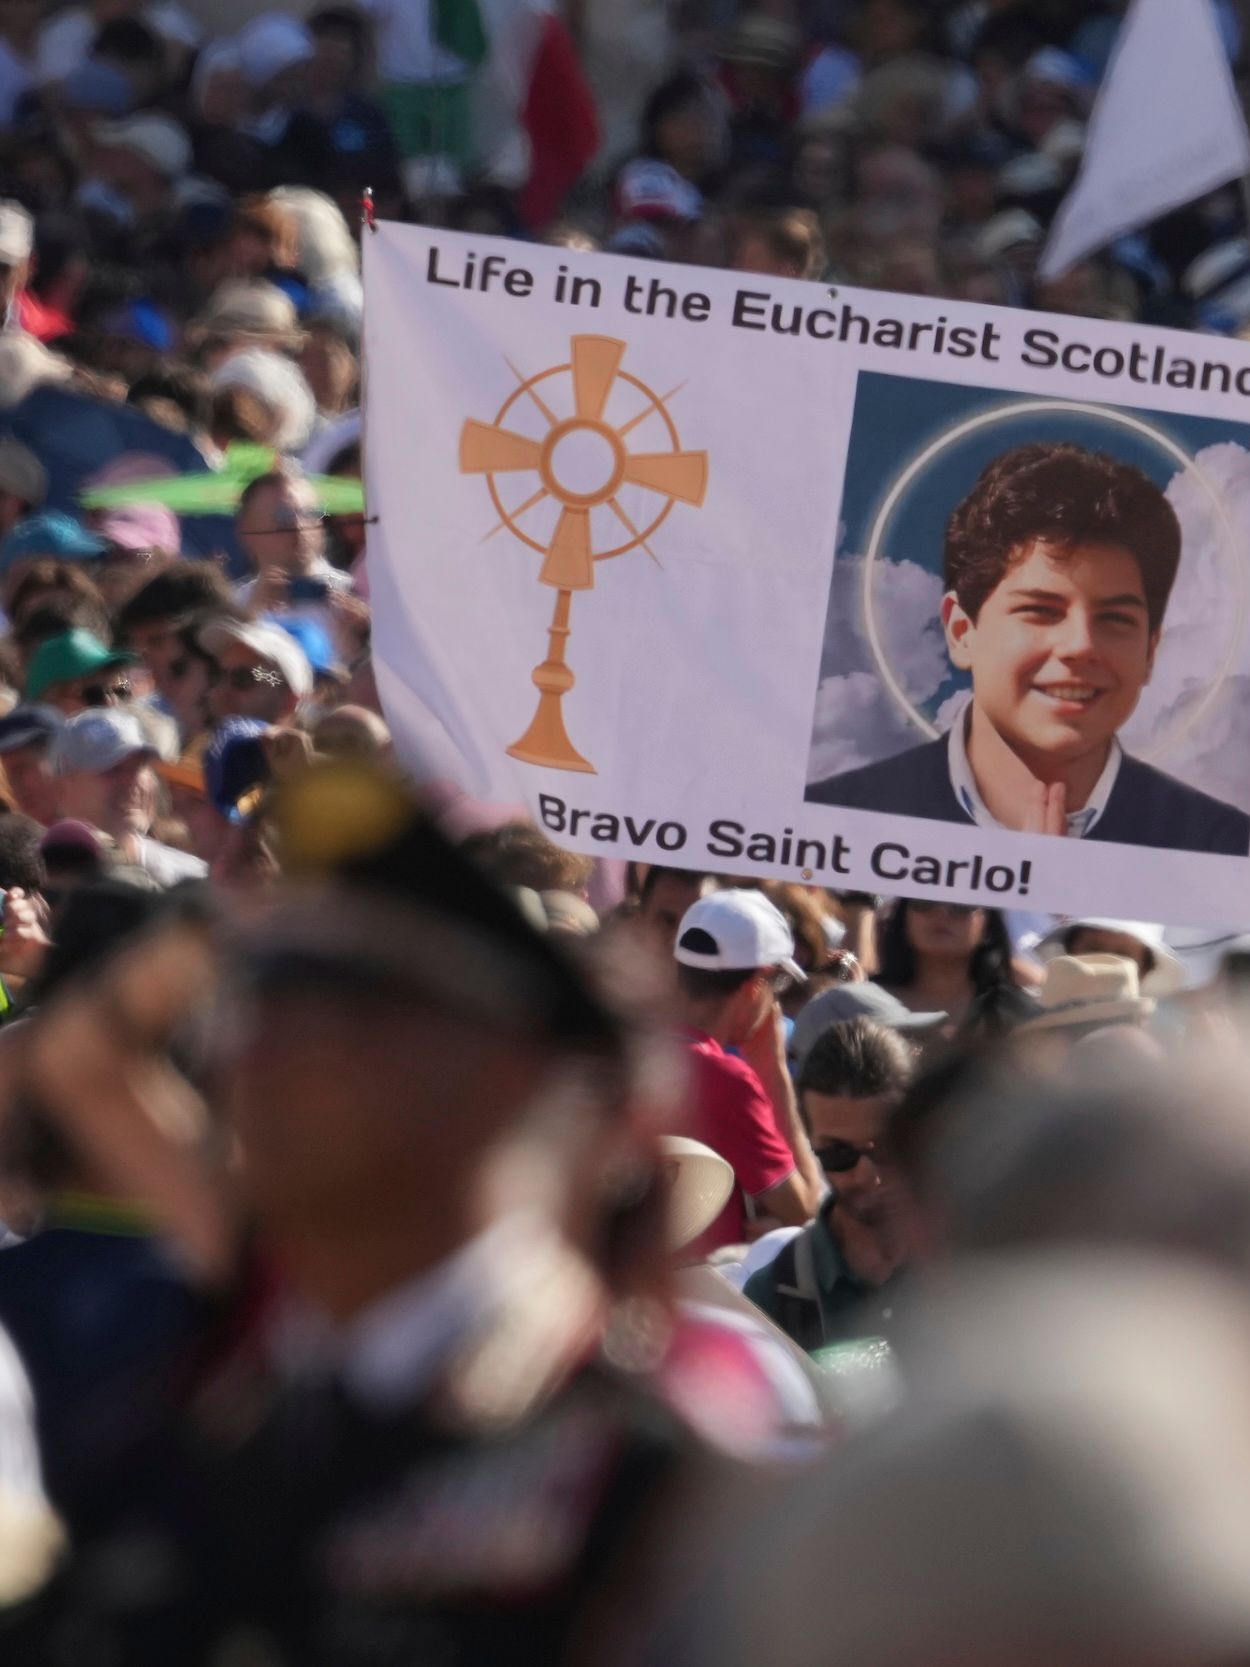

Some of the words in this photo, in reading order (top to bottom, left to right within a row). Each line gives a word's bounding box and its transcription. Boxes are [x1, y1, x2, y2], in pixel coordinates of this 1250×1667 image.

[426, 247, 535, 298] Life
[554, 265, 603, 308] in
[624, 275, 712, 323] the
[731, 288, 1001, 362] Eucharist
[538, 793, 688, 851] Bravo
[706, 818, 852, 875] Saint
[870, 842, 1032, 896] Carlo!
